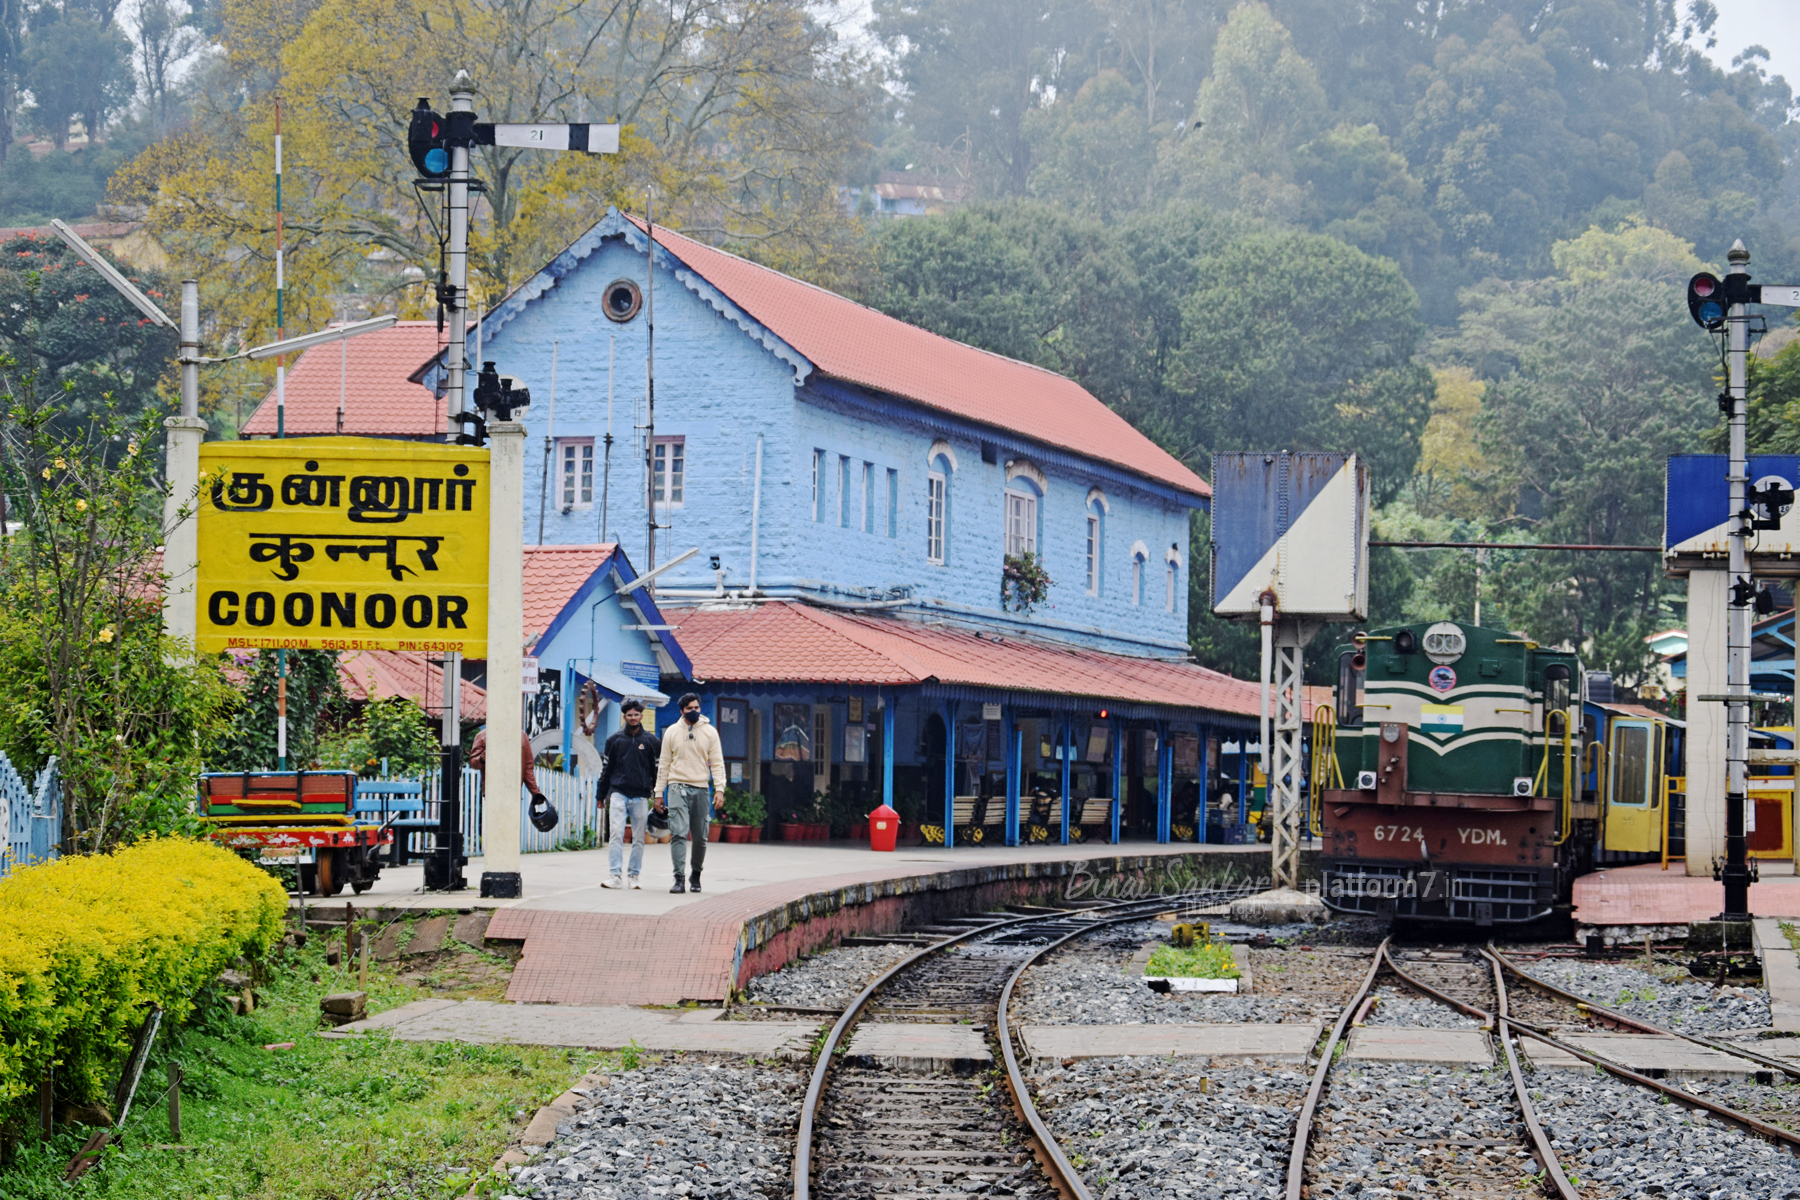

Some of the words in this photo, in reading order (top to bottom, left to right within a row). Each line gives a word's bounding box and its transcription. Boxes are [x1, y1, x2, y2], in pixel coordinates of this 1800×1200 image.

[530, 130, 543, 141] 21
[249, 532, 445, 582] कुन्नूर
[208, 591, 469, 630] COONOOR
[1373, 825, 1425, 843] 6724
